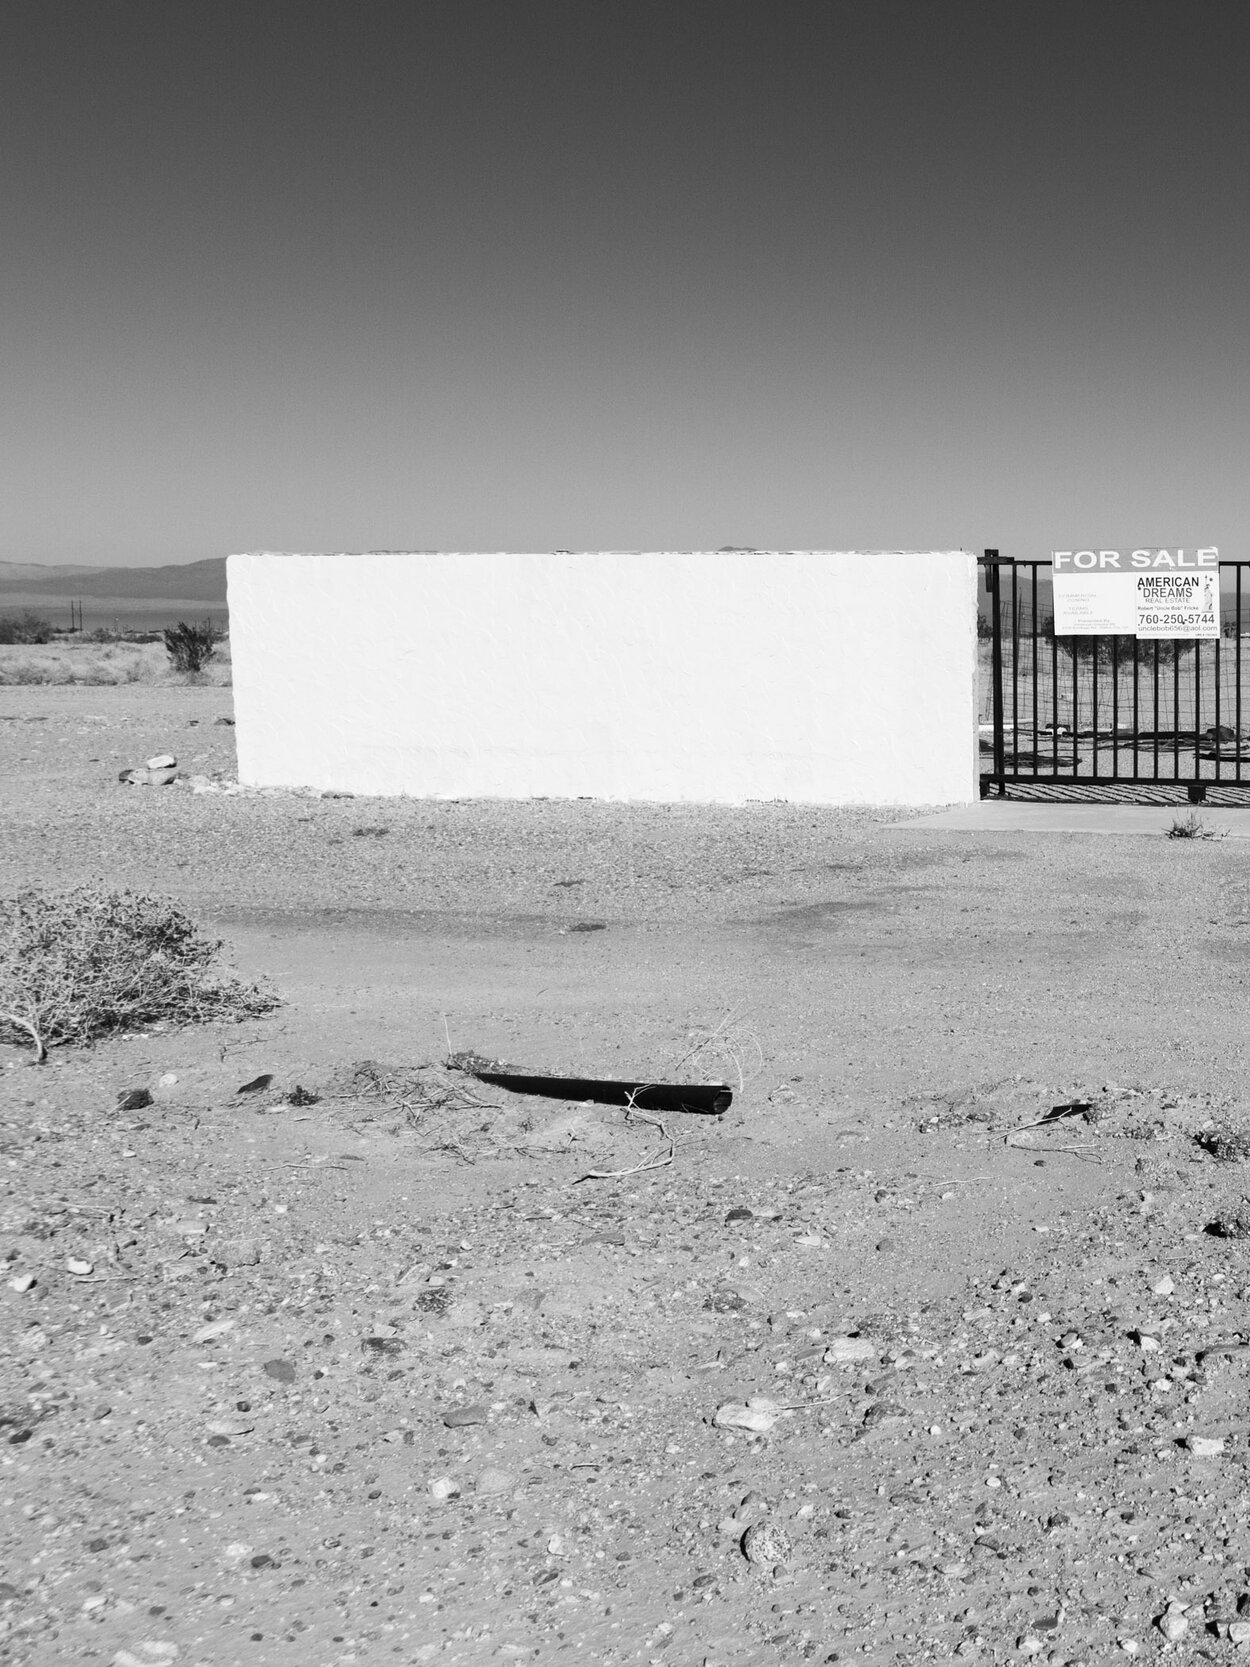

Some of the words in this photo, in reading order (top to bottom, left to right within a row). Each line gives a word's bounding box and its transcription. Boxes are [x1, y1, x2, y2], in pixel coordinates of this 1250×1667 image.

[1054, 551, 1121, 569] FOR
[1131, 549, 1217, 568] SALE
[1137, 577, 1199, 587] AMERICAN
[1143, 588, 1193, 598] DREAMS
[1139, 614, 1215, 624] 760-250-5744
